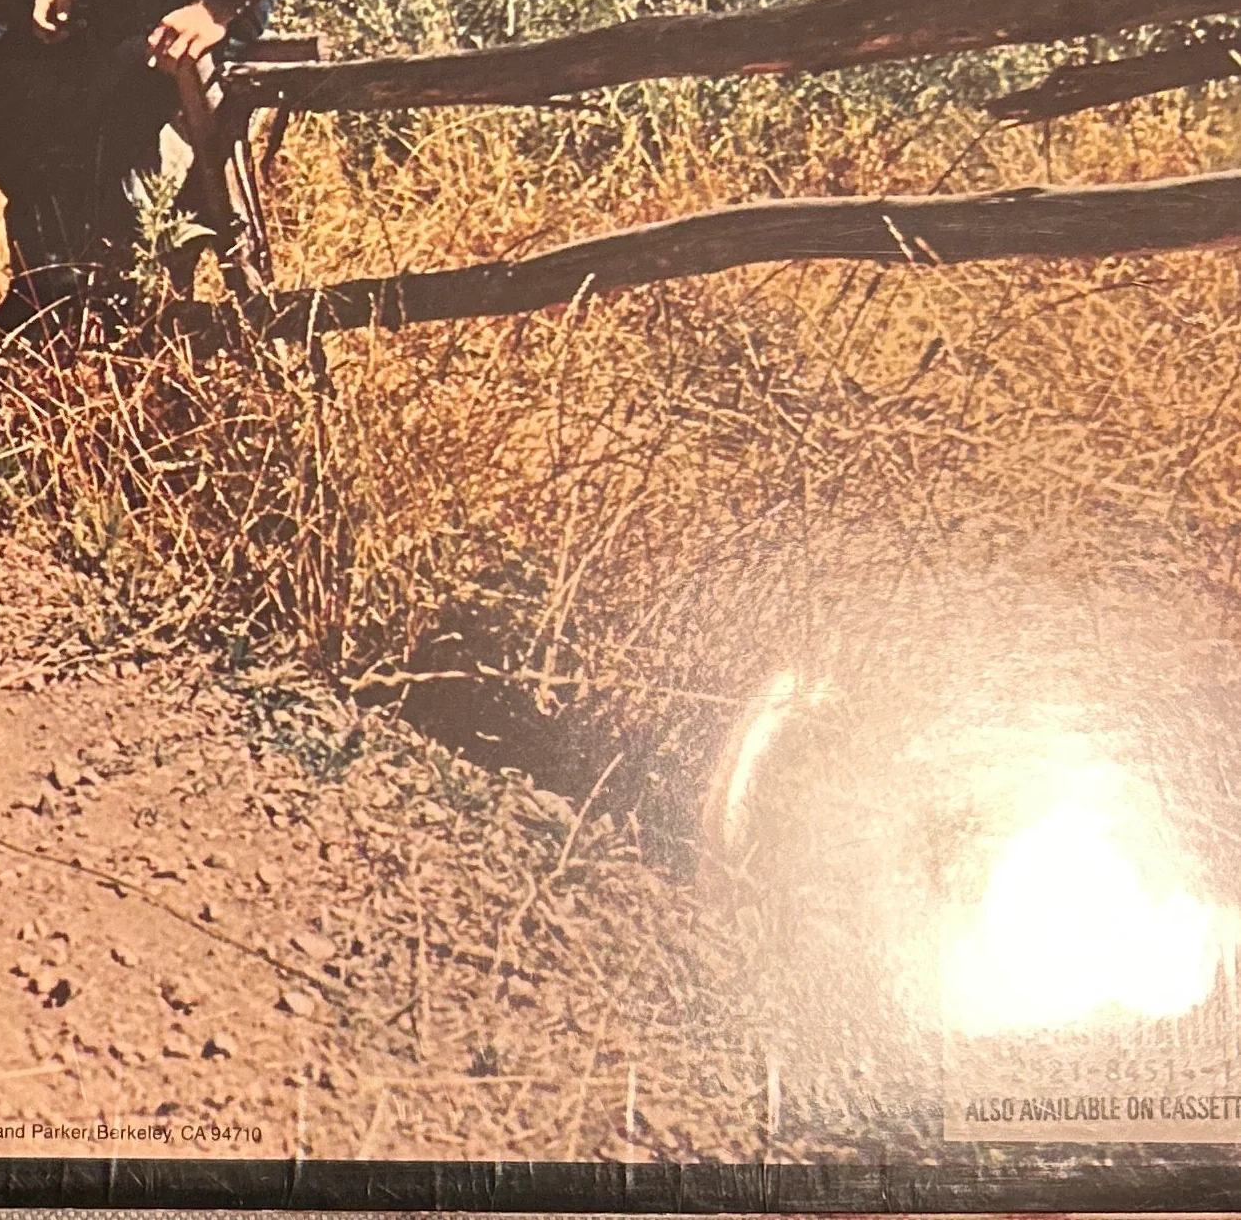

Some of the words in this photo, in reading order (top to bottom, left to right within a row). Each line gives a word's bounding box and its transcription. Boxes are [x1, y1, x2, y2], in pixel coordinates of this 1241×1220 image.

[965, 1097, 1015, 1122] ALSO
[1019, 1097, 1121, 1122] AVAILABLE
[1127, 1096, 1155, 1121] ON
[32, 1124, 92, 1143] Parker,
[97, 1124, 175, 1144] Berkeley,
[180, 1125, 207, 1142] CA
[211, 1126, 263, 1143] 94710
